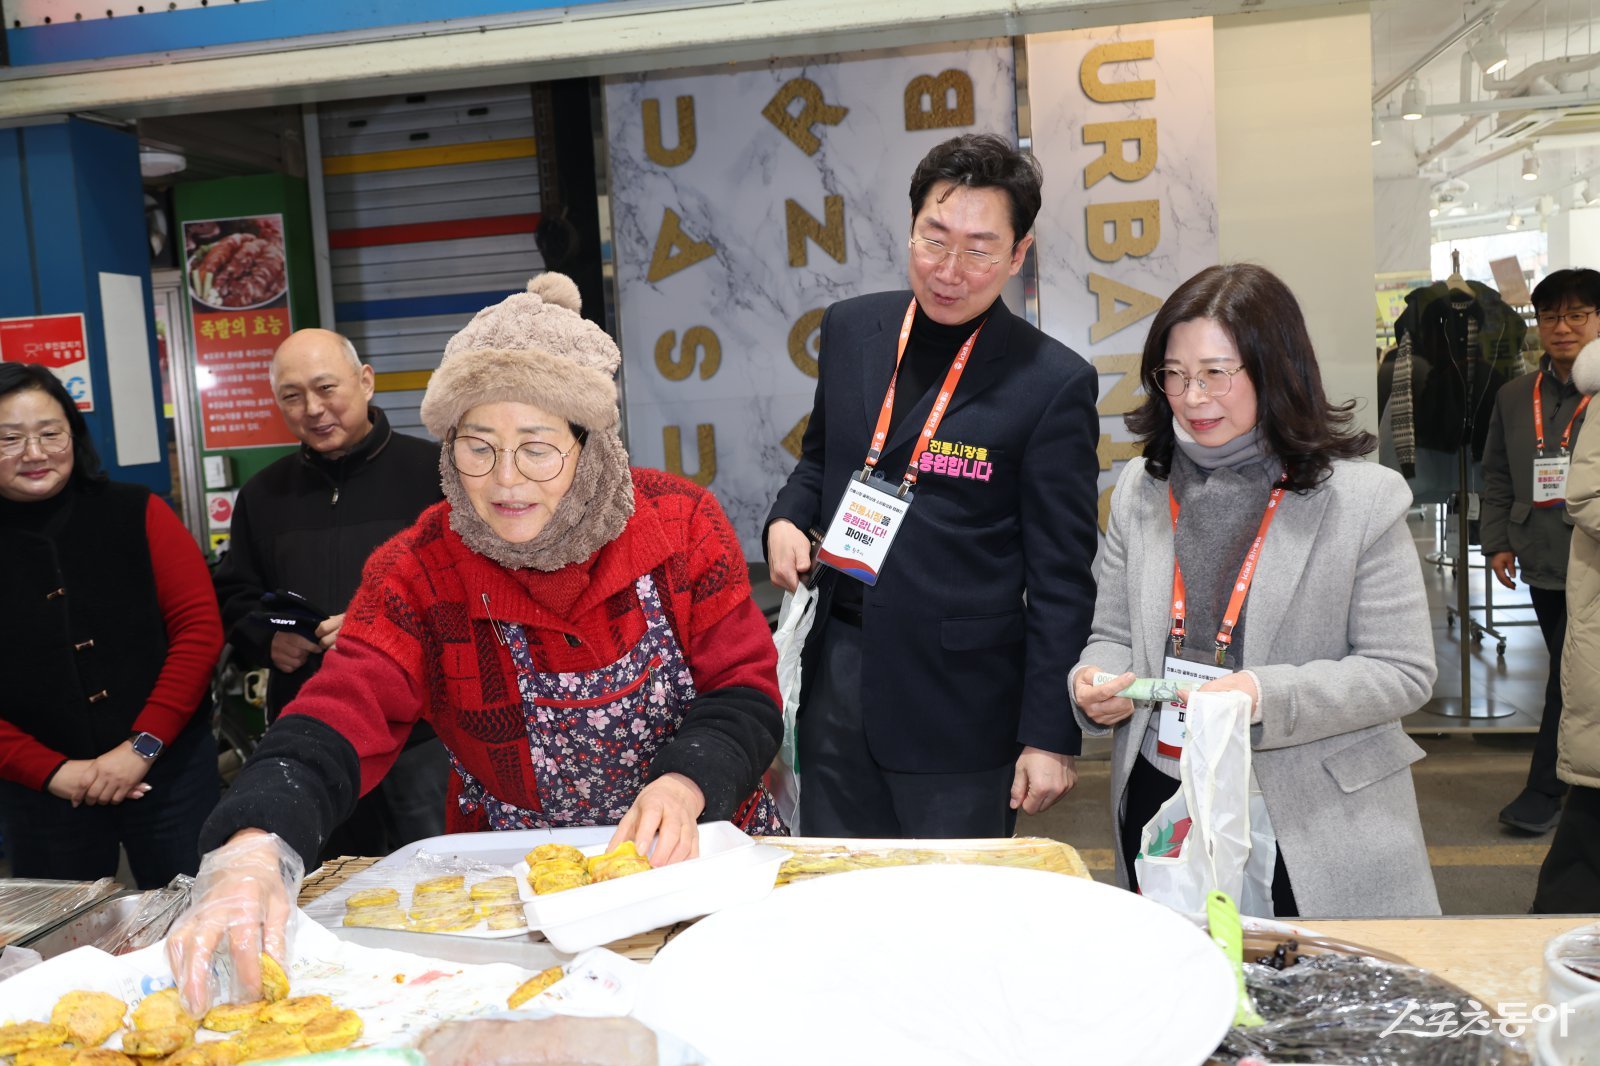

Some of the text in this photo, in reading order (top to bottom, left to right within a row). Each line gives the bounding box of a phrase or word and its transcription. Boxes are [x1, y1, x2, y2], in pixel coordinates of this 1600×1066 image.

[201, 315, 283, 340] 족발의 효능
[929, 439, 988, 461] 전통시장을
[918, 451, 993, 482] 응원합니다
[842, 512, 888, 539] 응원합니다!
[848, 501, 892, 527] 전통시장을
[845, 527, 875, 546] 파이팅!
